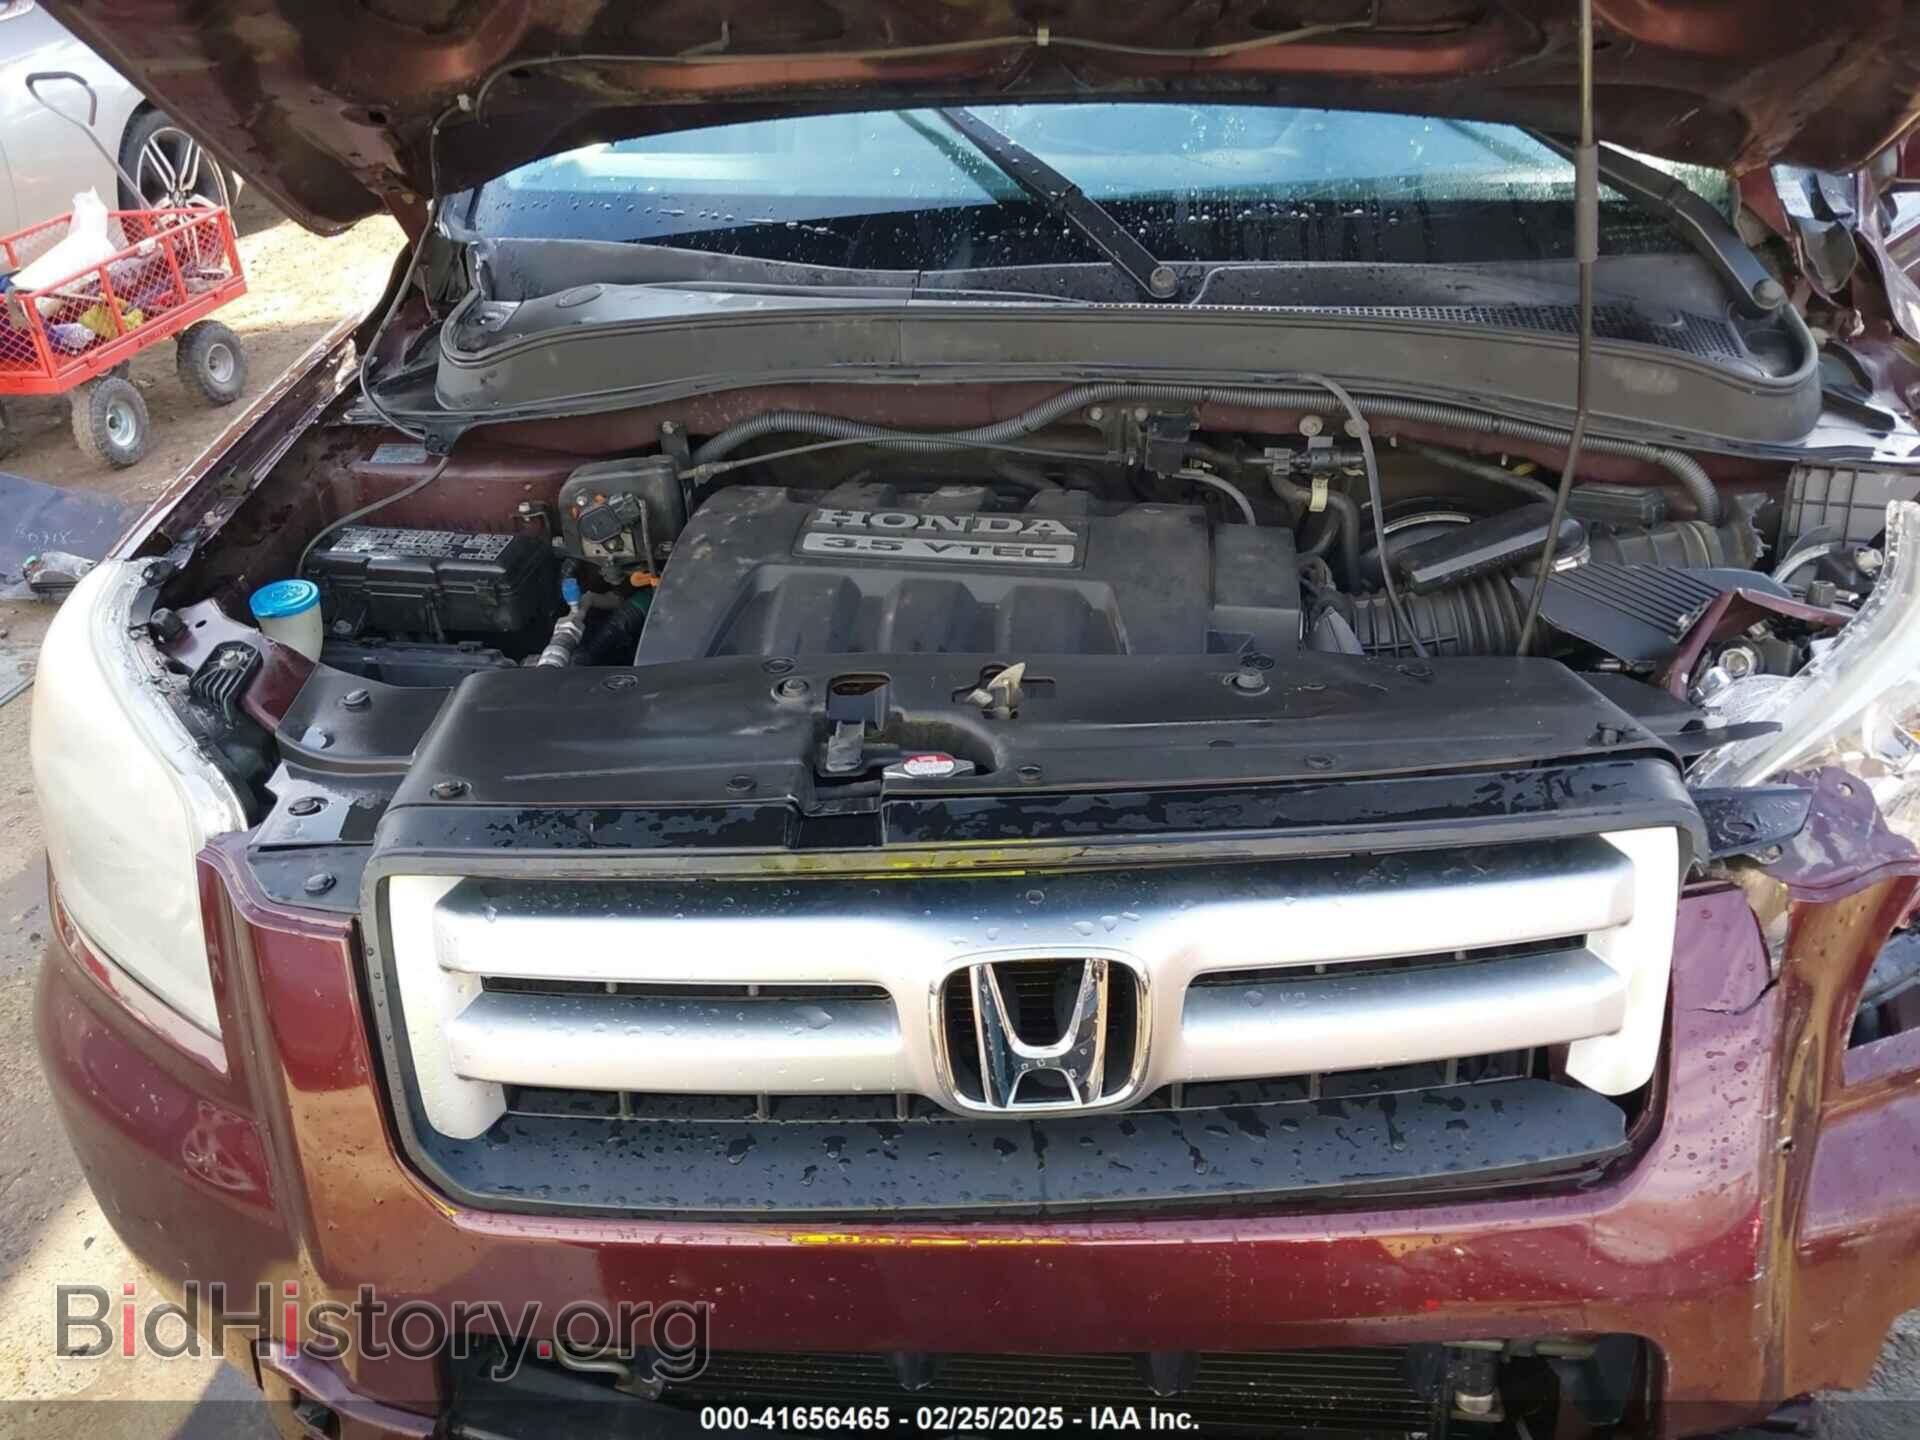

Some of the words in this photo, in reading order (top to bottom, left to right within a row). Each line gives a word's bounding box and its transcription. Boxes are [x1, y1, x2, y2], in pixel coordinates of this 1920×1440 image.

[812, 508, 1078, 537] HONDA
[823, 536, 904, 552] 3.5
[923, 541, 1058, 560] VTEC
